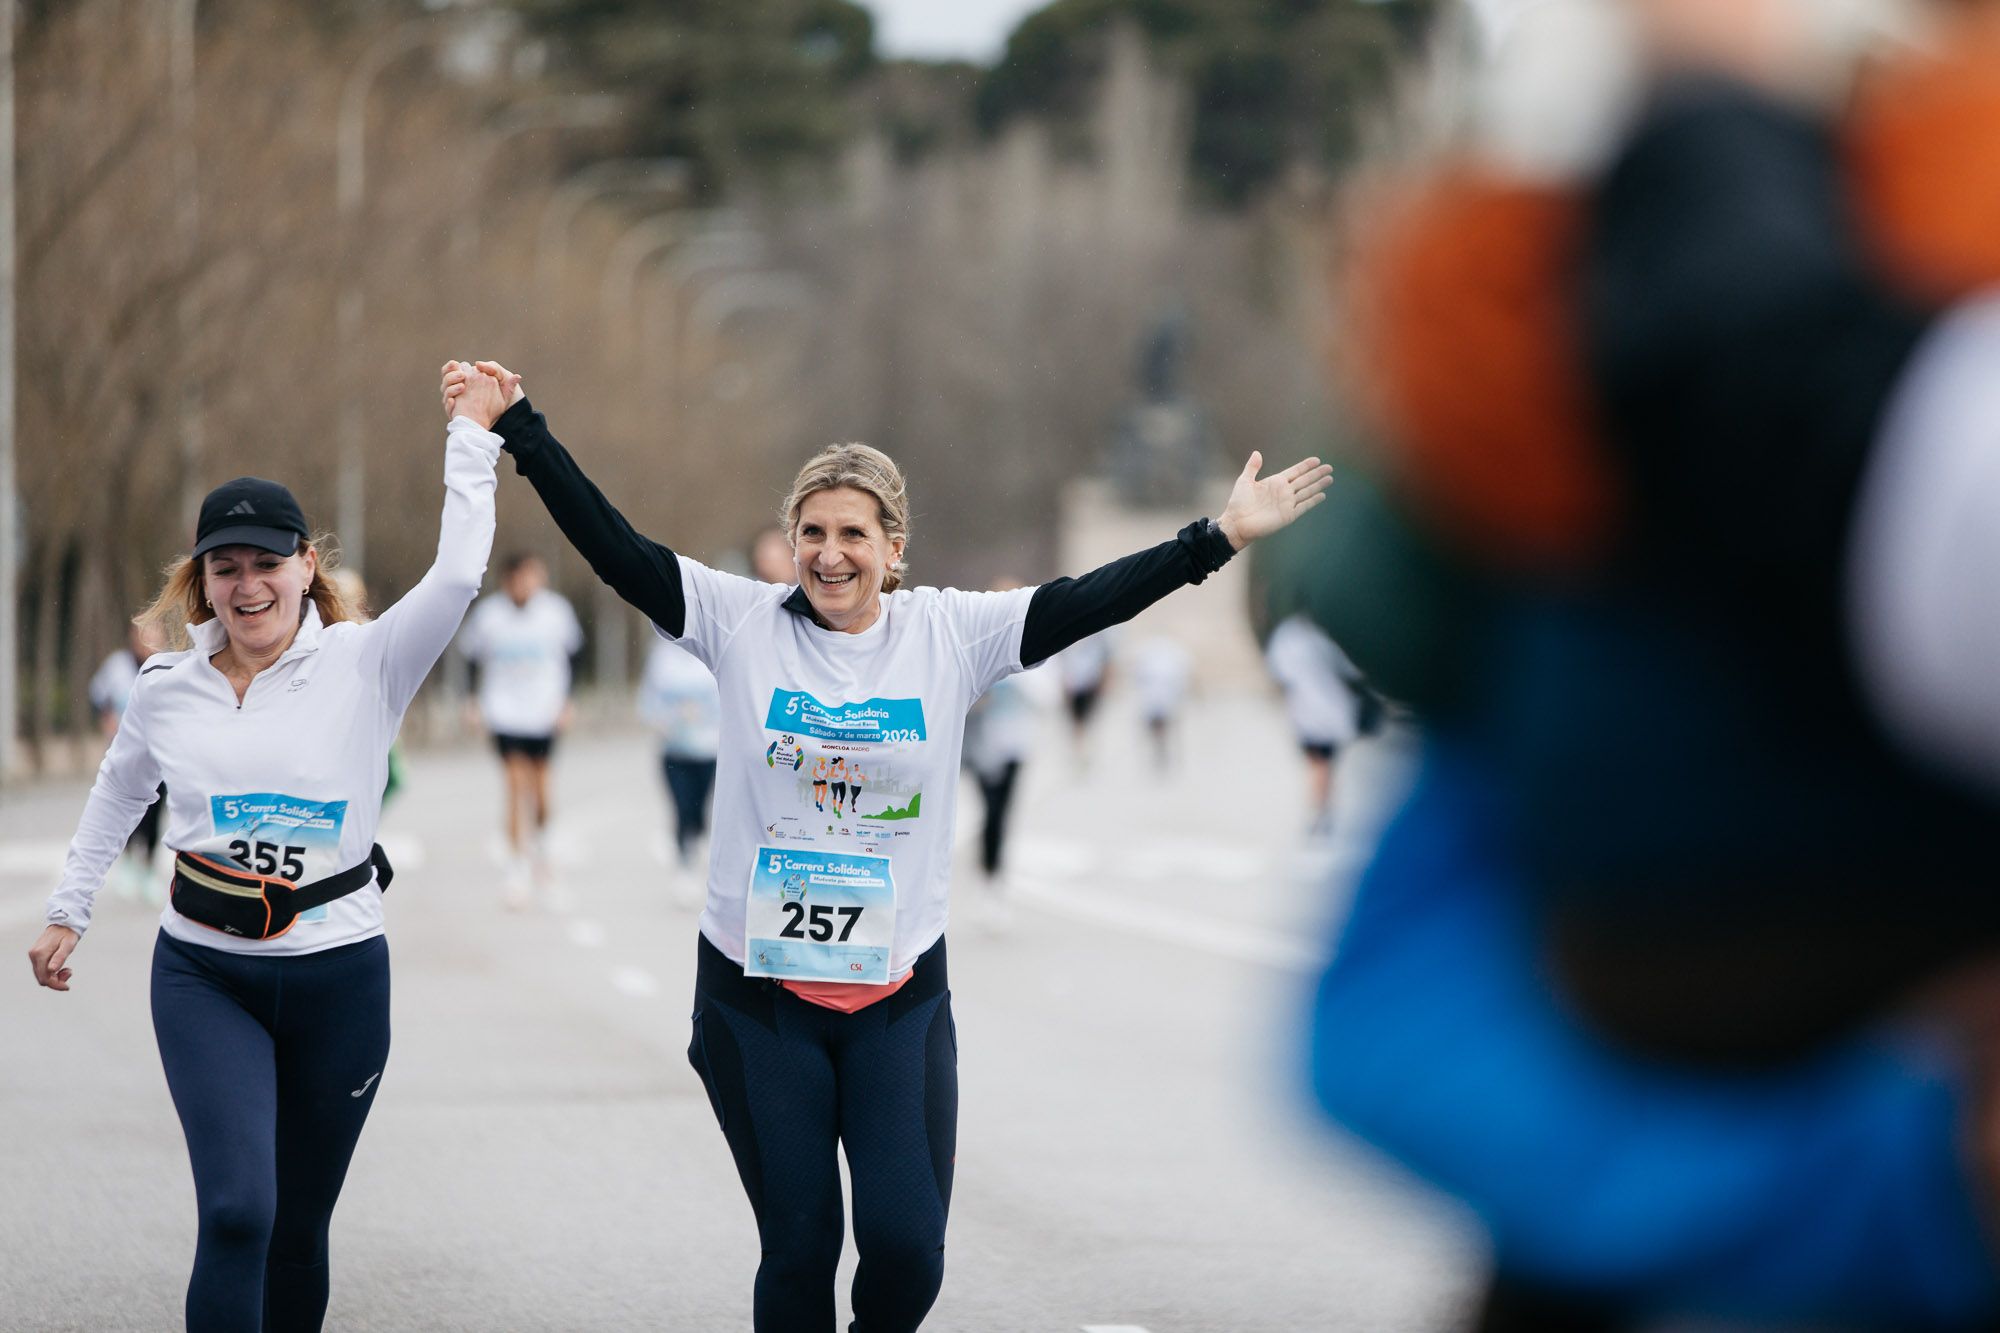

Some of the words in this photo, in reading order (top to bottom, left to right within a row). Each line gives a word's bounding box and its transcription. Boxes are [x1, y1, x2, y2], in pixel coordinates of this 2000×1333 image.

[844, 707, 889, 719] Solidaria
[781, 734, 795, 745] 20
[809, 727, 836, 738] Sábado
[881, 729, 920, 743] 2026
[279, 804, 325, 818] Solida
[228, 839, 307, 883] 255
[784, 859, 824, 873] Carrera
[827, 862, 871, 877] Solidaria
[779, 901, 865, 942] 257
